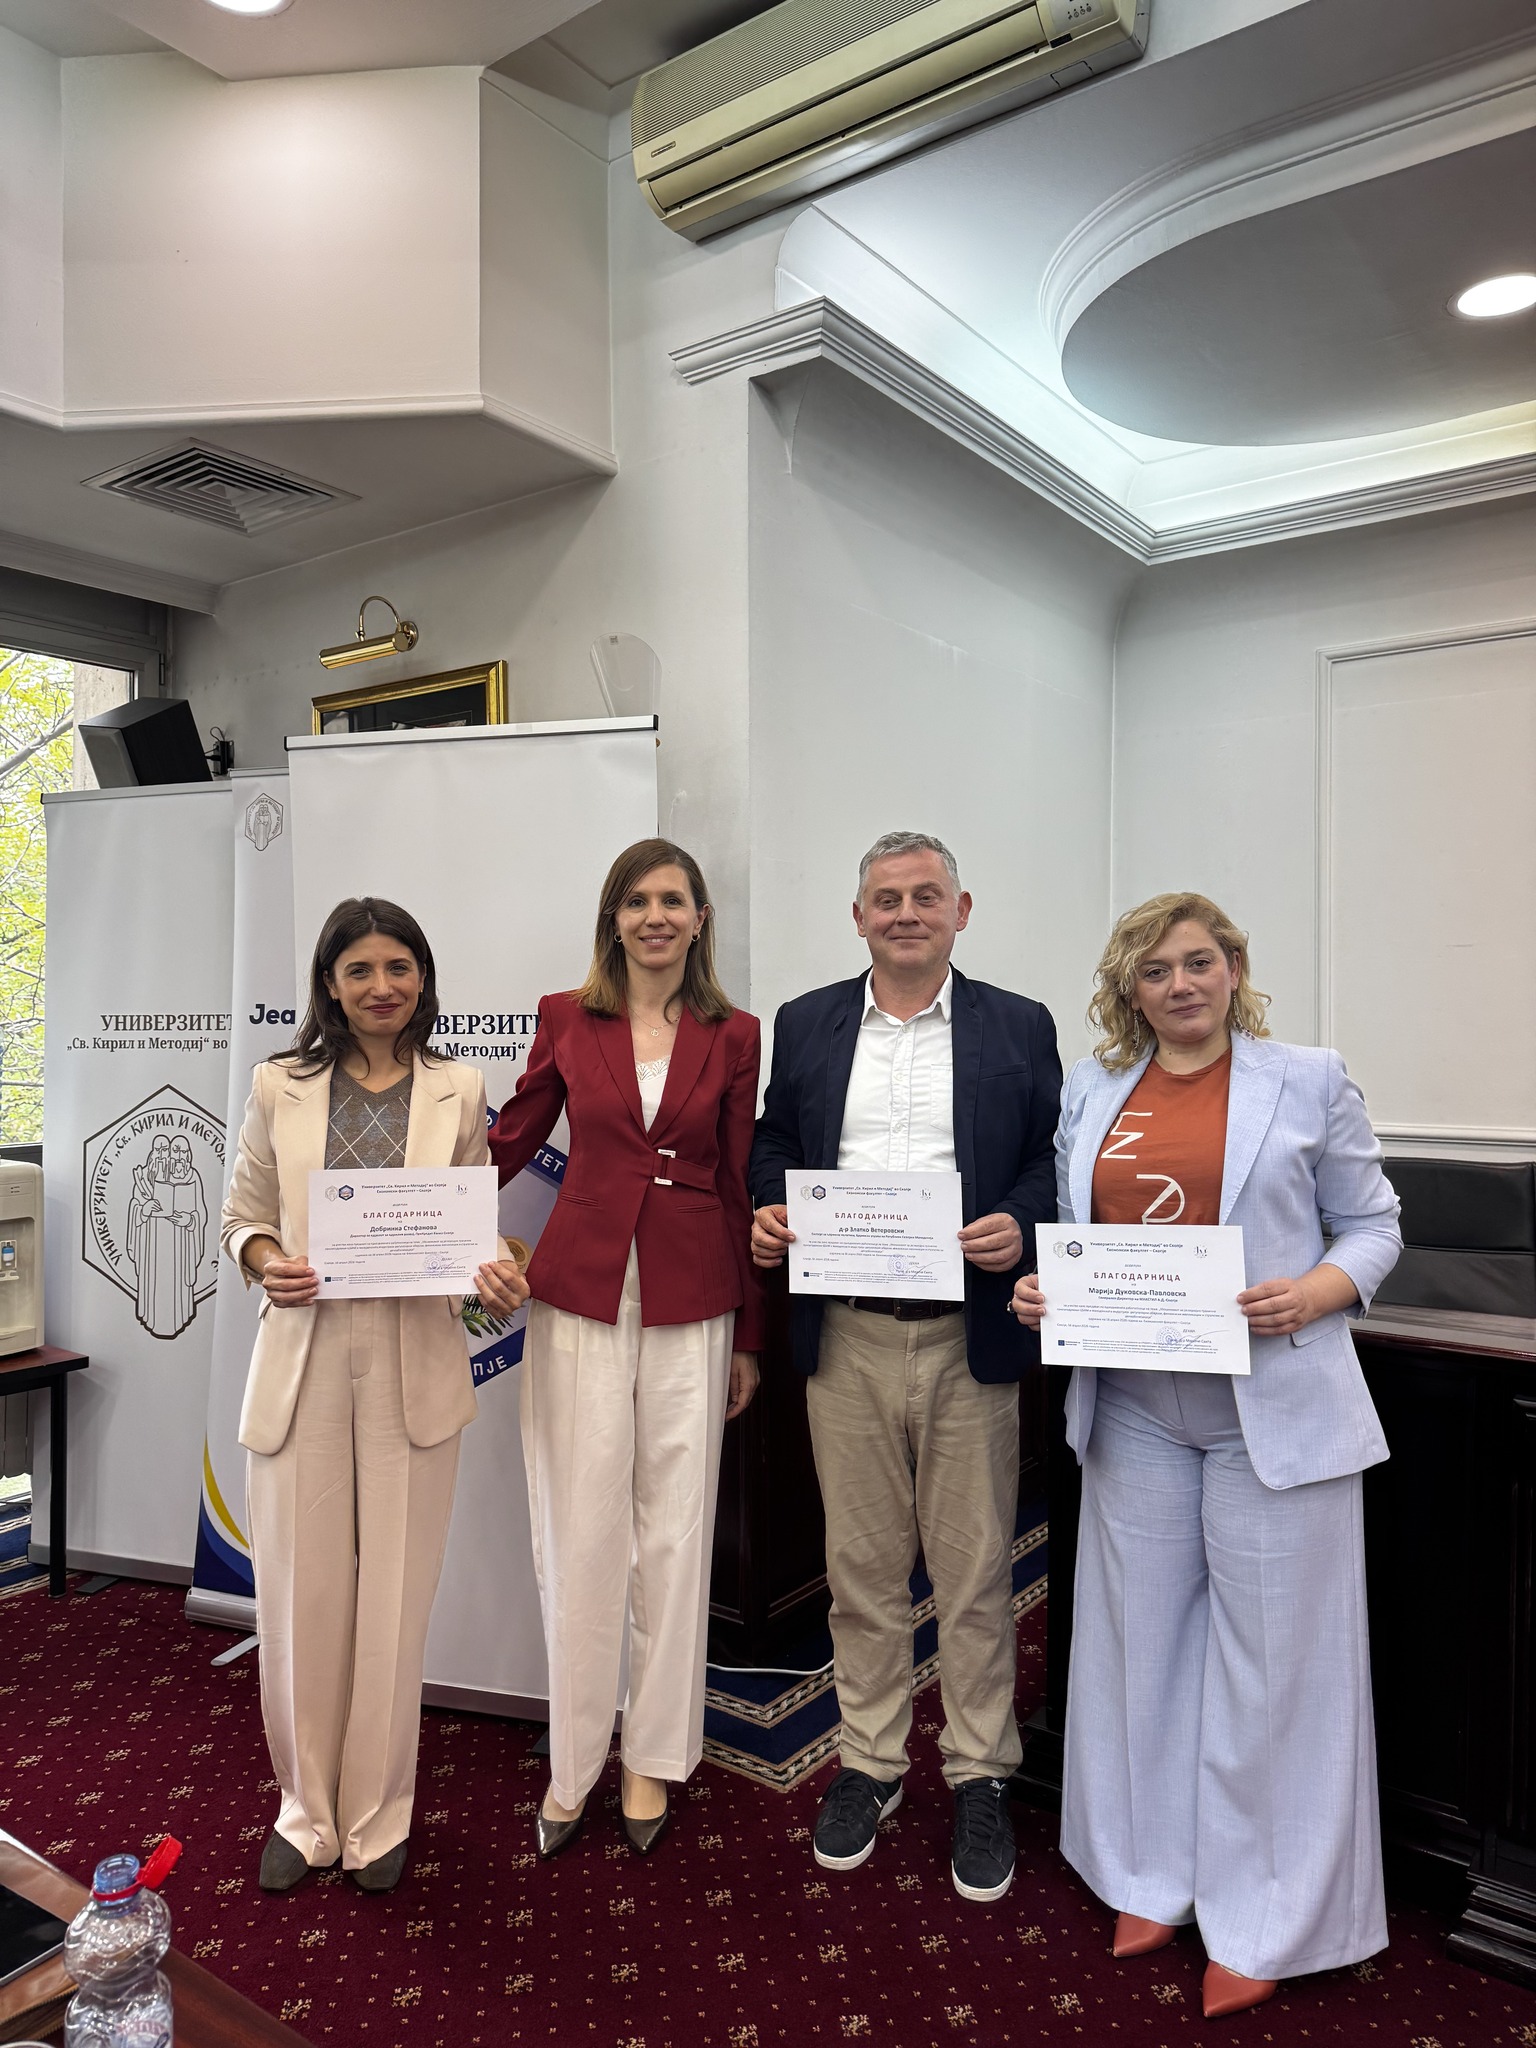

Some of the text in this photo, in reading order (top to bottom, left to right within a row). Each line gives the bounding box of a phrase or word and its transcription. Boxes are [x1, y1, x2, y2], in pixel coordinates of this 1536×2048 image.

[249, 1004, 296, 1024] Jea
[431, 1014, 541, 1034] ВЕРЗИТ
[93, 1037, 136, 1052] Кирил
[138, 1041, 146, 1049] и
[213, 1041, 228, 1049] во
[130, 1113, 174, 1137] КИРИЛ
[178, 1114, 190, 1130] И
